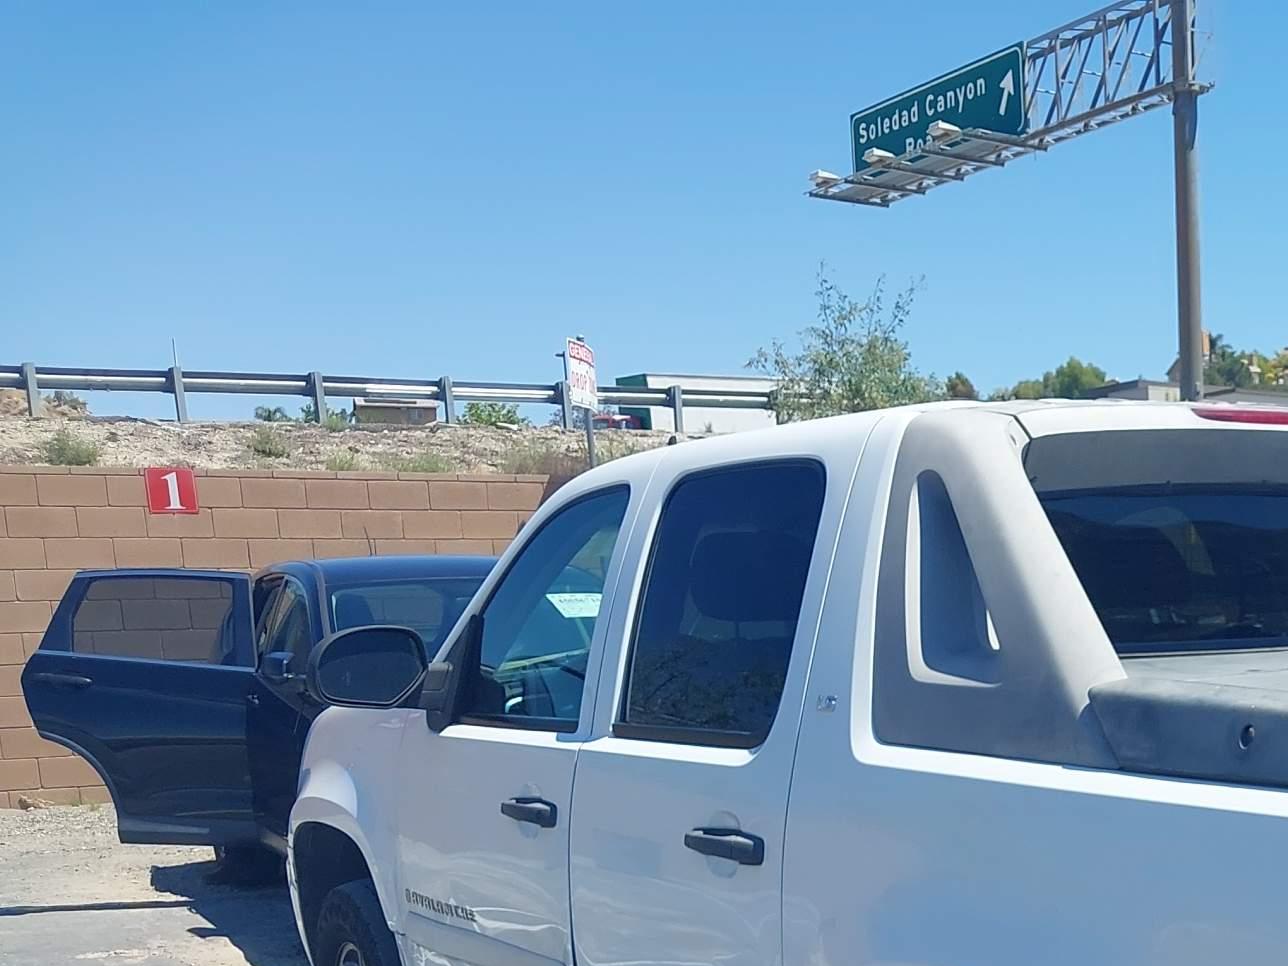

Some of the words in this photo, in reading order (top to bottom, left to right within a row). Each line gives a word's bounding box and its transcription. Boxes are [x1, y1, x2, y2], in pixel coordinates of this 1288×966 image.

[859, 101, 918, 144] Soledad
[925, 78, 986, 116] Canyon
[905, 134, 935, 154] Roa
[160, 471, 187, 510] 1
